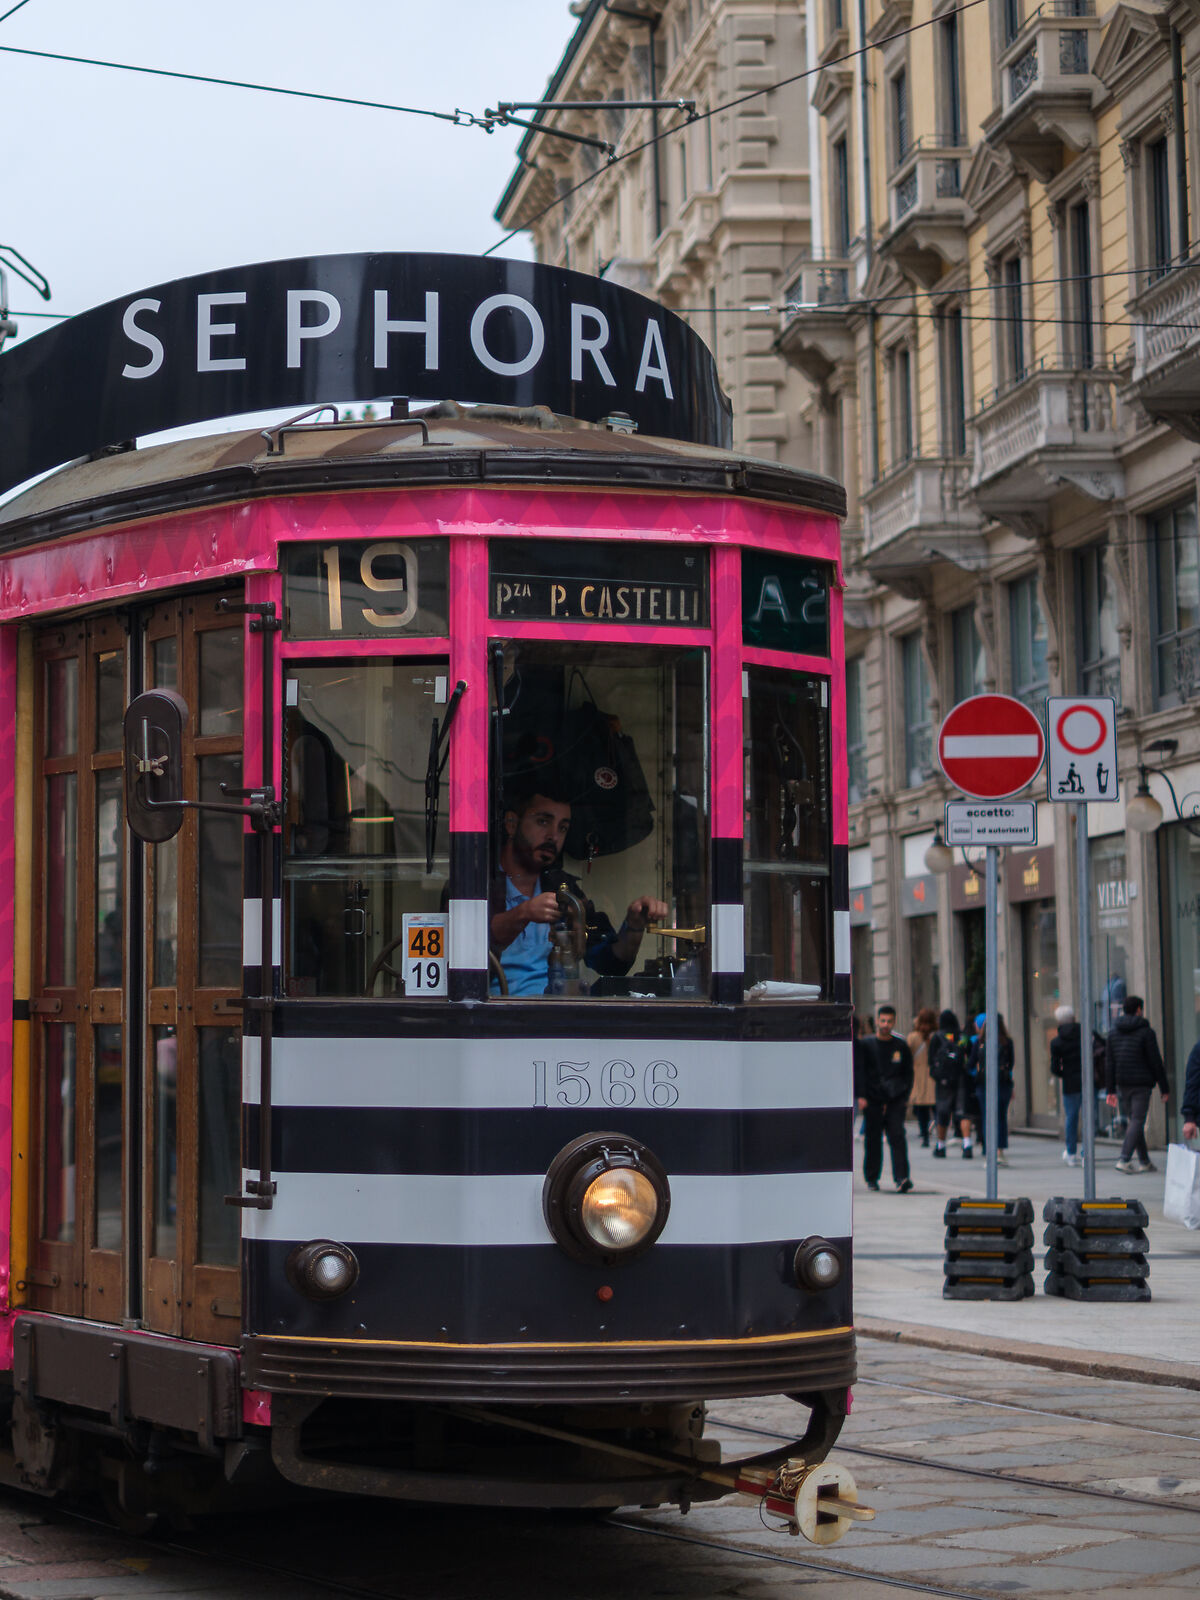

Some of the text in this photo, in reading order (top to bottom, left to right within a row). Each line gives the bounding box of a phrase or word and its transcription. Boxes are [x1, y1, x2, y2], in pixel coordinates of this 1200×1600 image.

[121, 289, 674, 400] SEPHORA
[323, 542, 418, 631] 19
[580, 585, 699, 622] CASTELLI
[966, 807, 1015, 817] eccetto:
[410, 929, 441, 956] 48
[412, 961, 441, 989] 19
[532, 1059, 679, 1108] 1566
